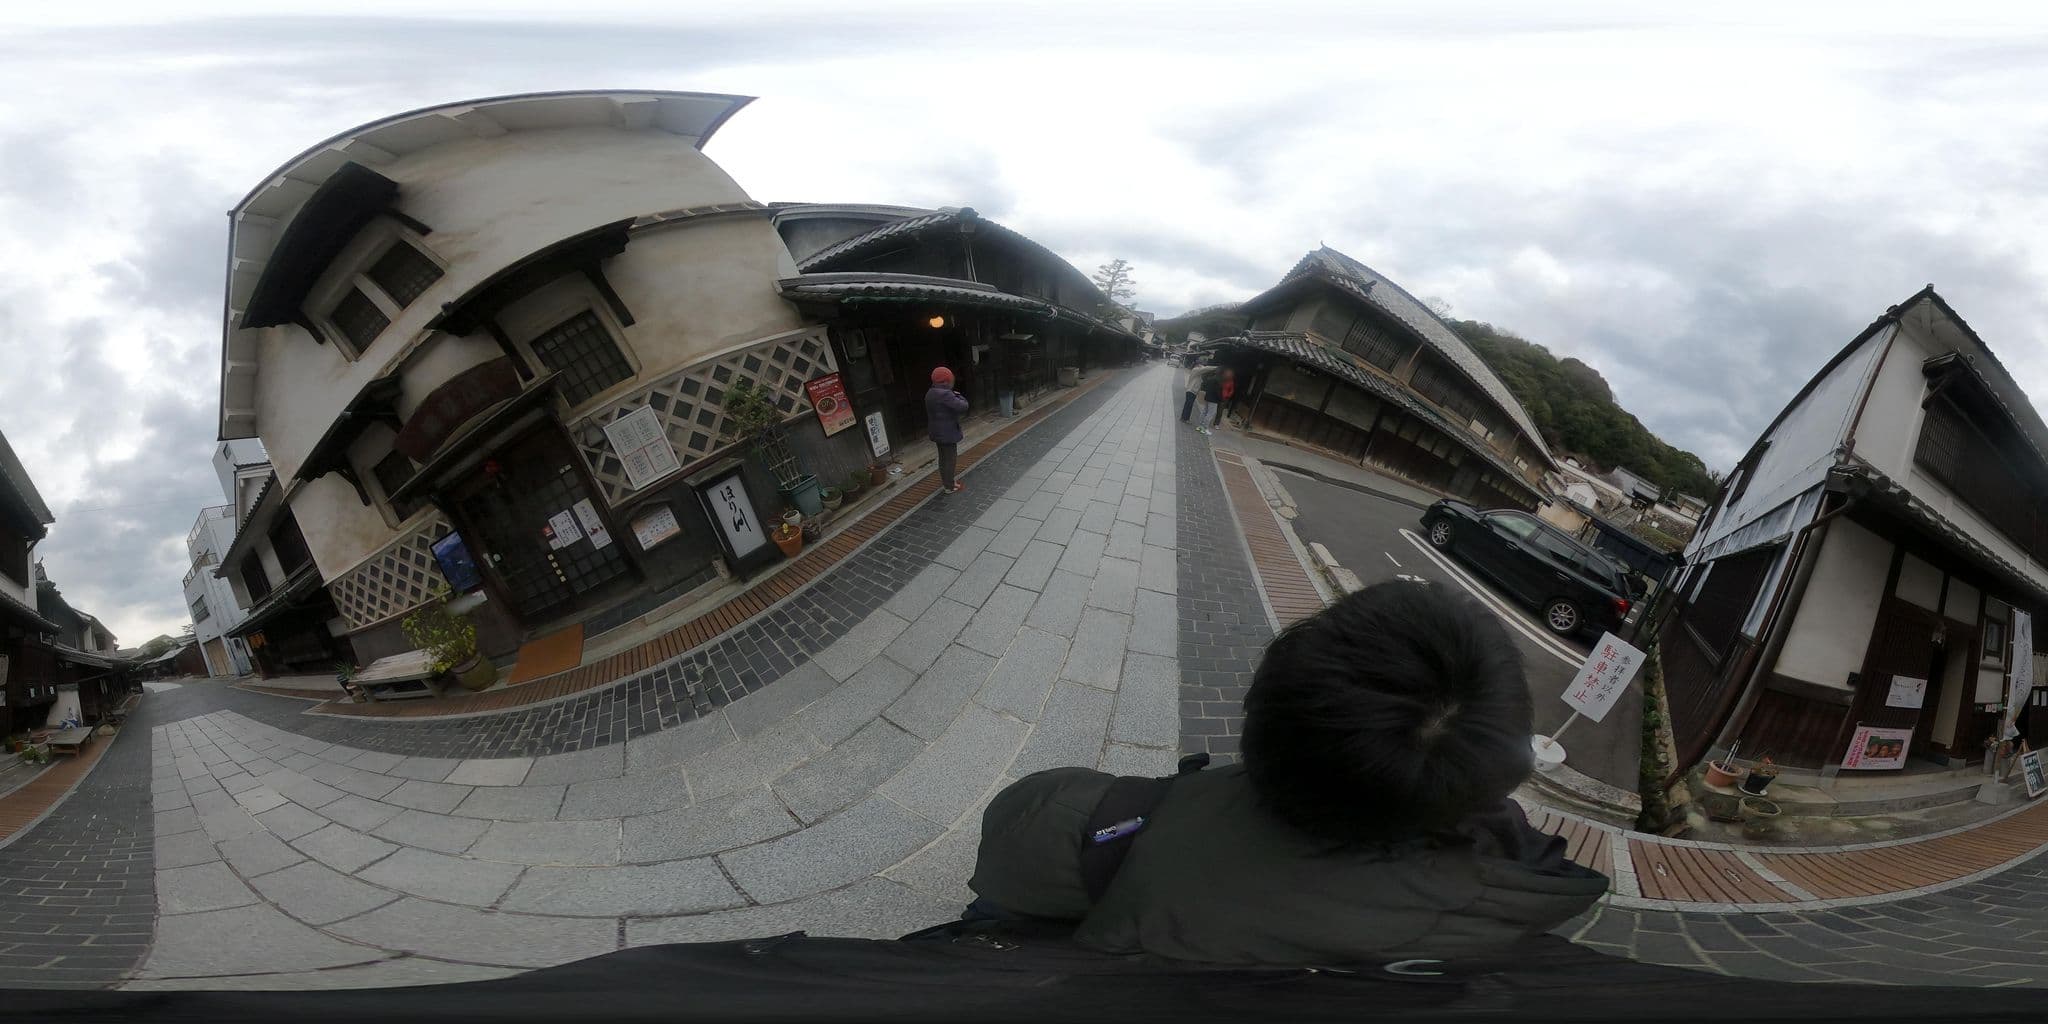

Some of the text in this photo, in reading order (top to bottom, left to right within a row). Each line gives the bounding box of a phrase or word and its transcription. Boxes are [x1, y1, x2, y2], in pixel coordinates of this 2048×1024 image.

[720, 485, 752, 533] ほり川
[1573, 644, 1619, 704] 駐車禁止
[1595, 655, 1632, 703] 参拝者以外
